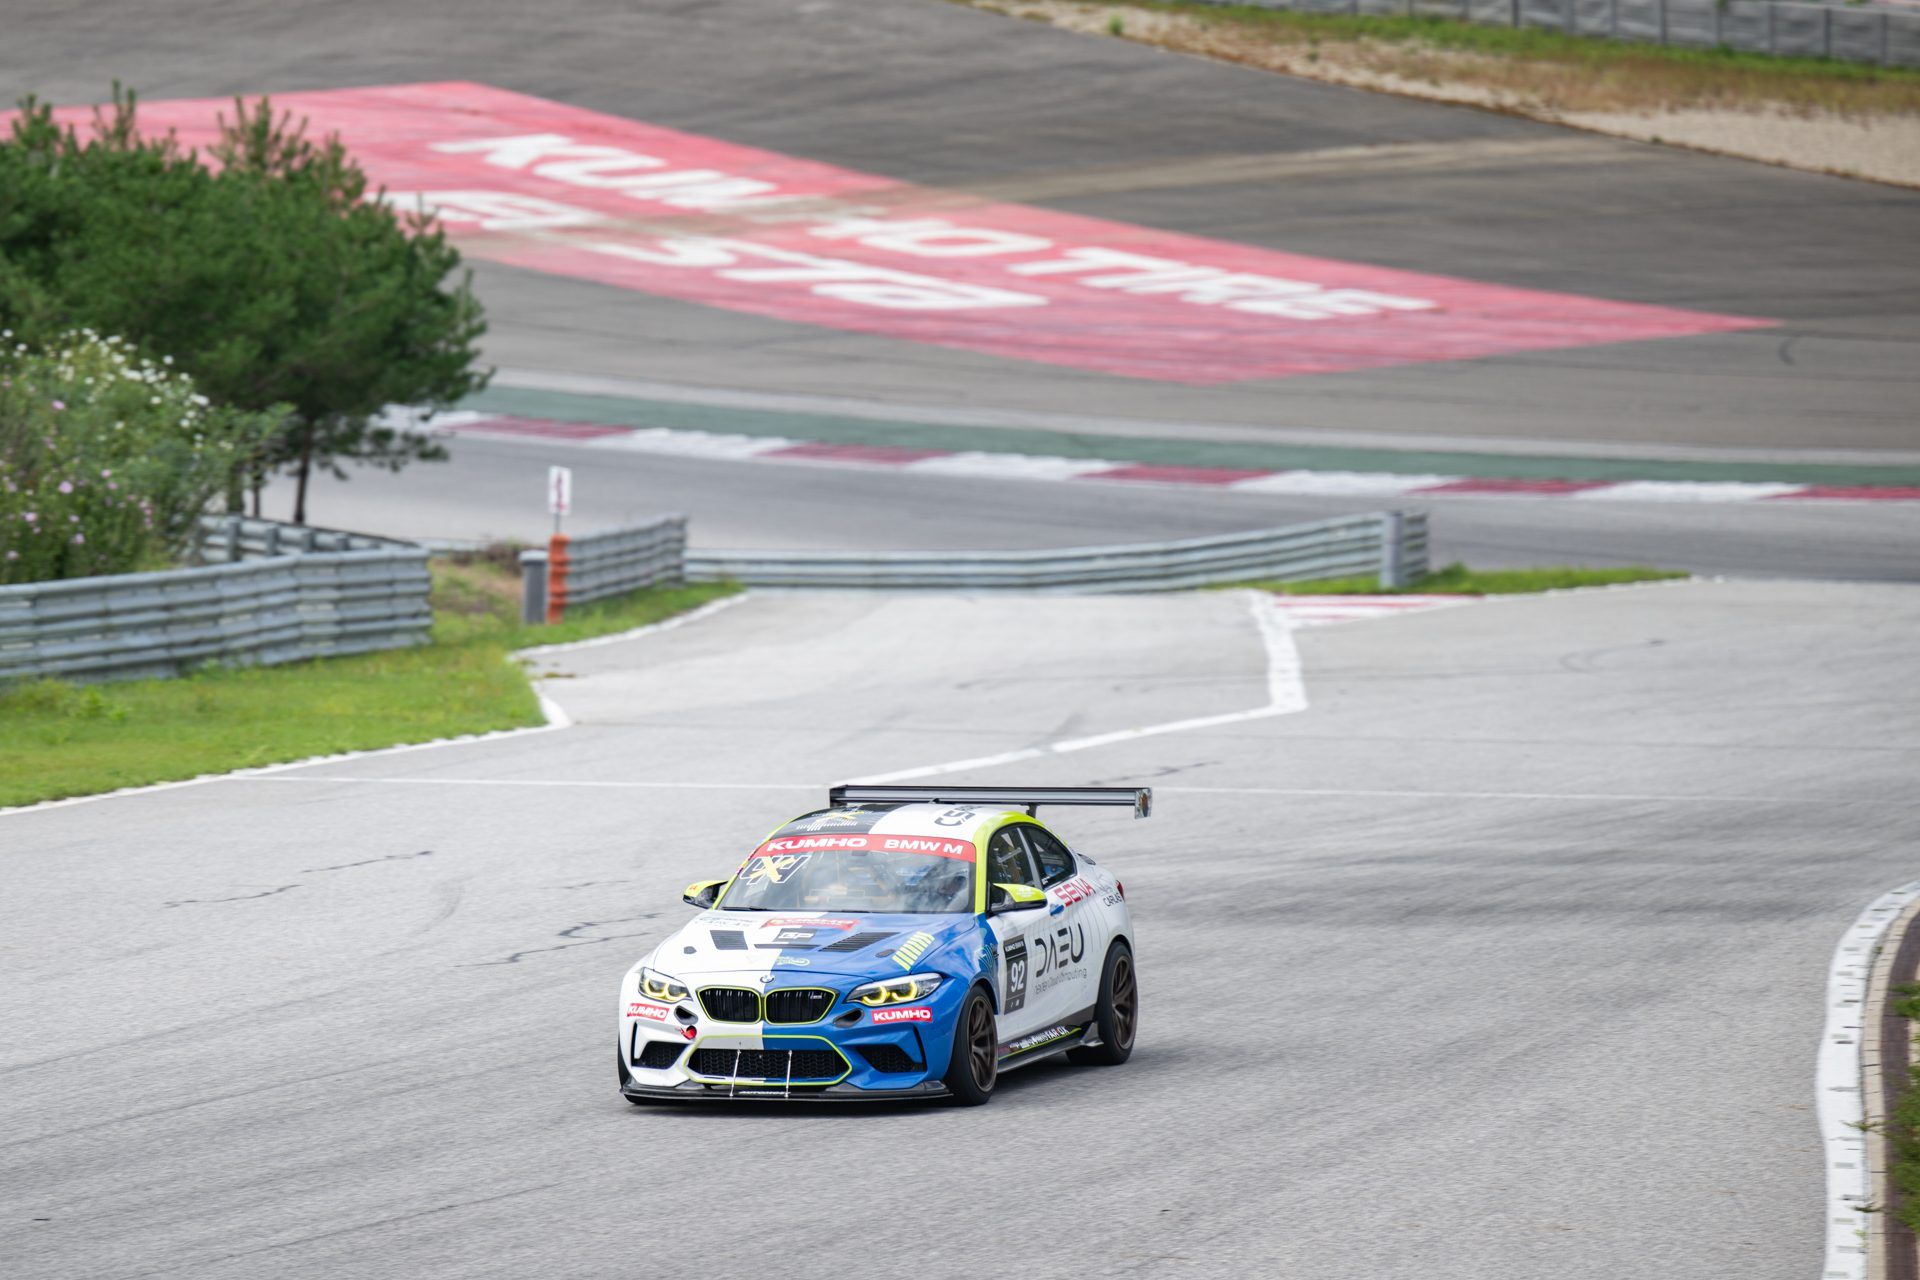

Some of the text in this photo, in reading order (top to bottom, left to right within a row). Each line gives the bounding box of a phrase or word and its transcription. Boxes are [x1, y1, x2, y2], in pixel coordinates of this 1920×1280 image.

[429, 134, 1437, 318] KUMHO TIRE
[766, 837, 964, 855] KUMHO BMW M
[1054, 878, 1096, 907] SENA
[1011, 961, 1025, 992] 92
[626, 1004, 668, 1019] KUMHO
[873, 1009, 931, 1022] KUMHO
